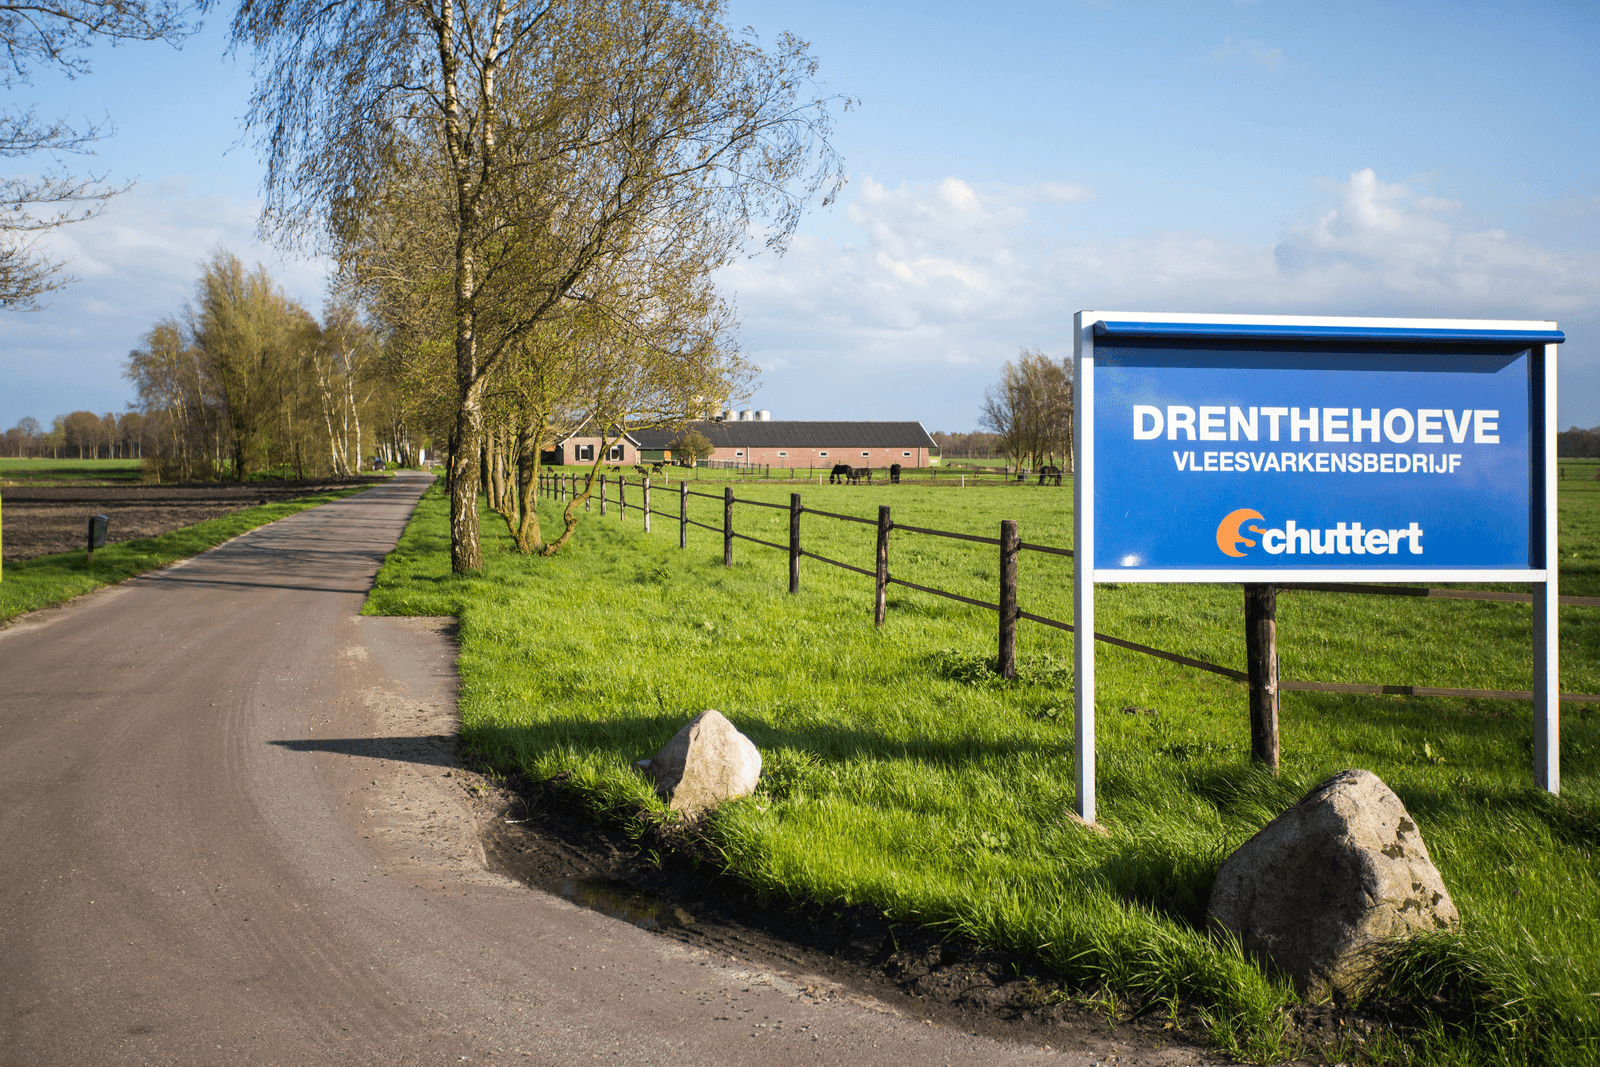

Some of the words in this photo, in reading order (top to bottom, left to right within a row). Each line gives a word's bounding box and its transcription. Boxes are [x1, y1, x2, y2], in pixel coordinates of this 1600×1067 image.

[1132, 404, 1500, 444] DRENTHEHOEVE
[1172, 451, 1463, 474] VLEESVARKENSBEDRIJF
[1216, 508, 1424, 557] Schuttert
